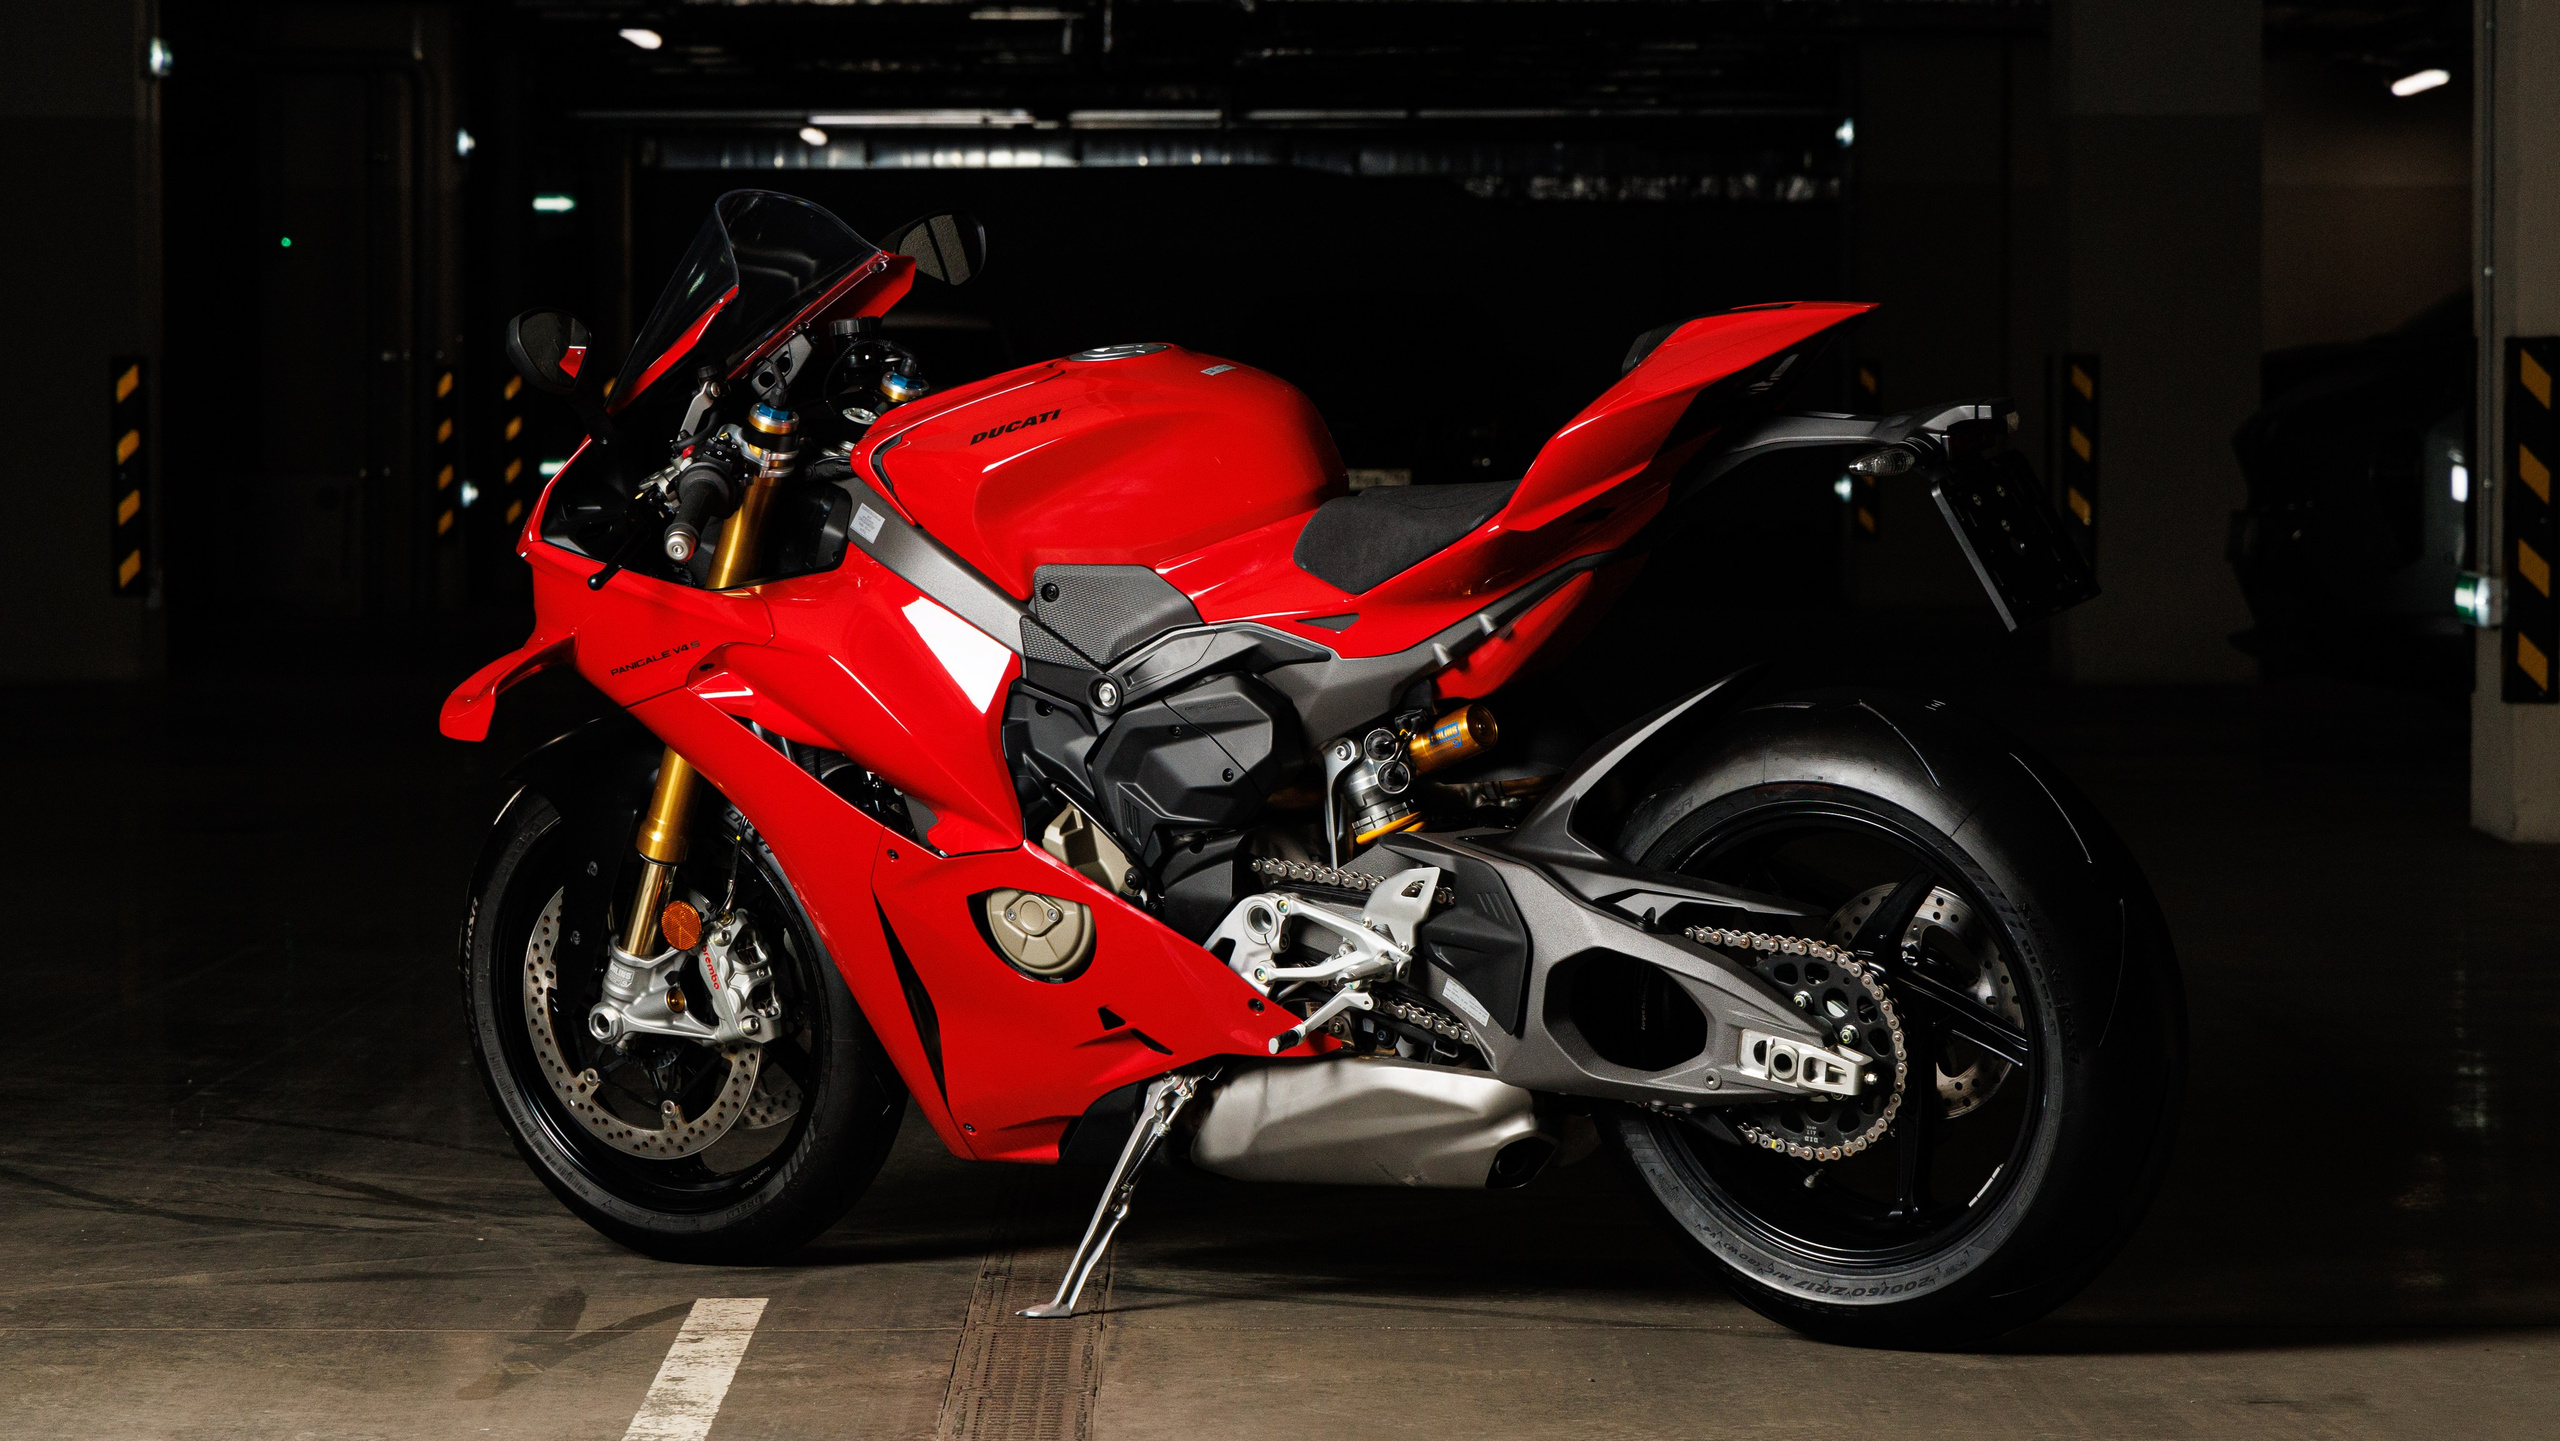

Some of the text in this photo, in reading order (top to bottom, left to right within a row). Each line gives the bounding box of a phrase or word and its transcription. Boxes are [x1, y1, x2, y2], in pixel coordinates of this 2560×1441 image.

[969, 408, 1062, 446] DUCATI
[610, 640, 701, 676] PANIGALE V4 S
[701, 944, 720, 990] brembo
[1793, 1280, 1849, 1297] ZR17
[1852, 1275, 1931, 1298] 200/60
